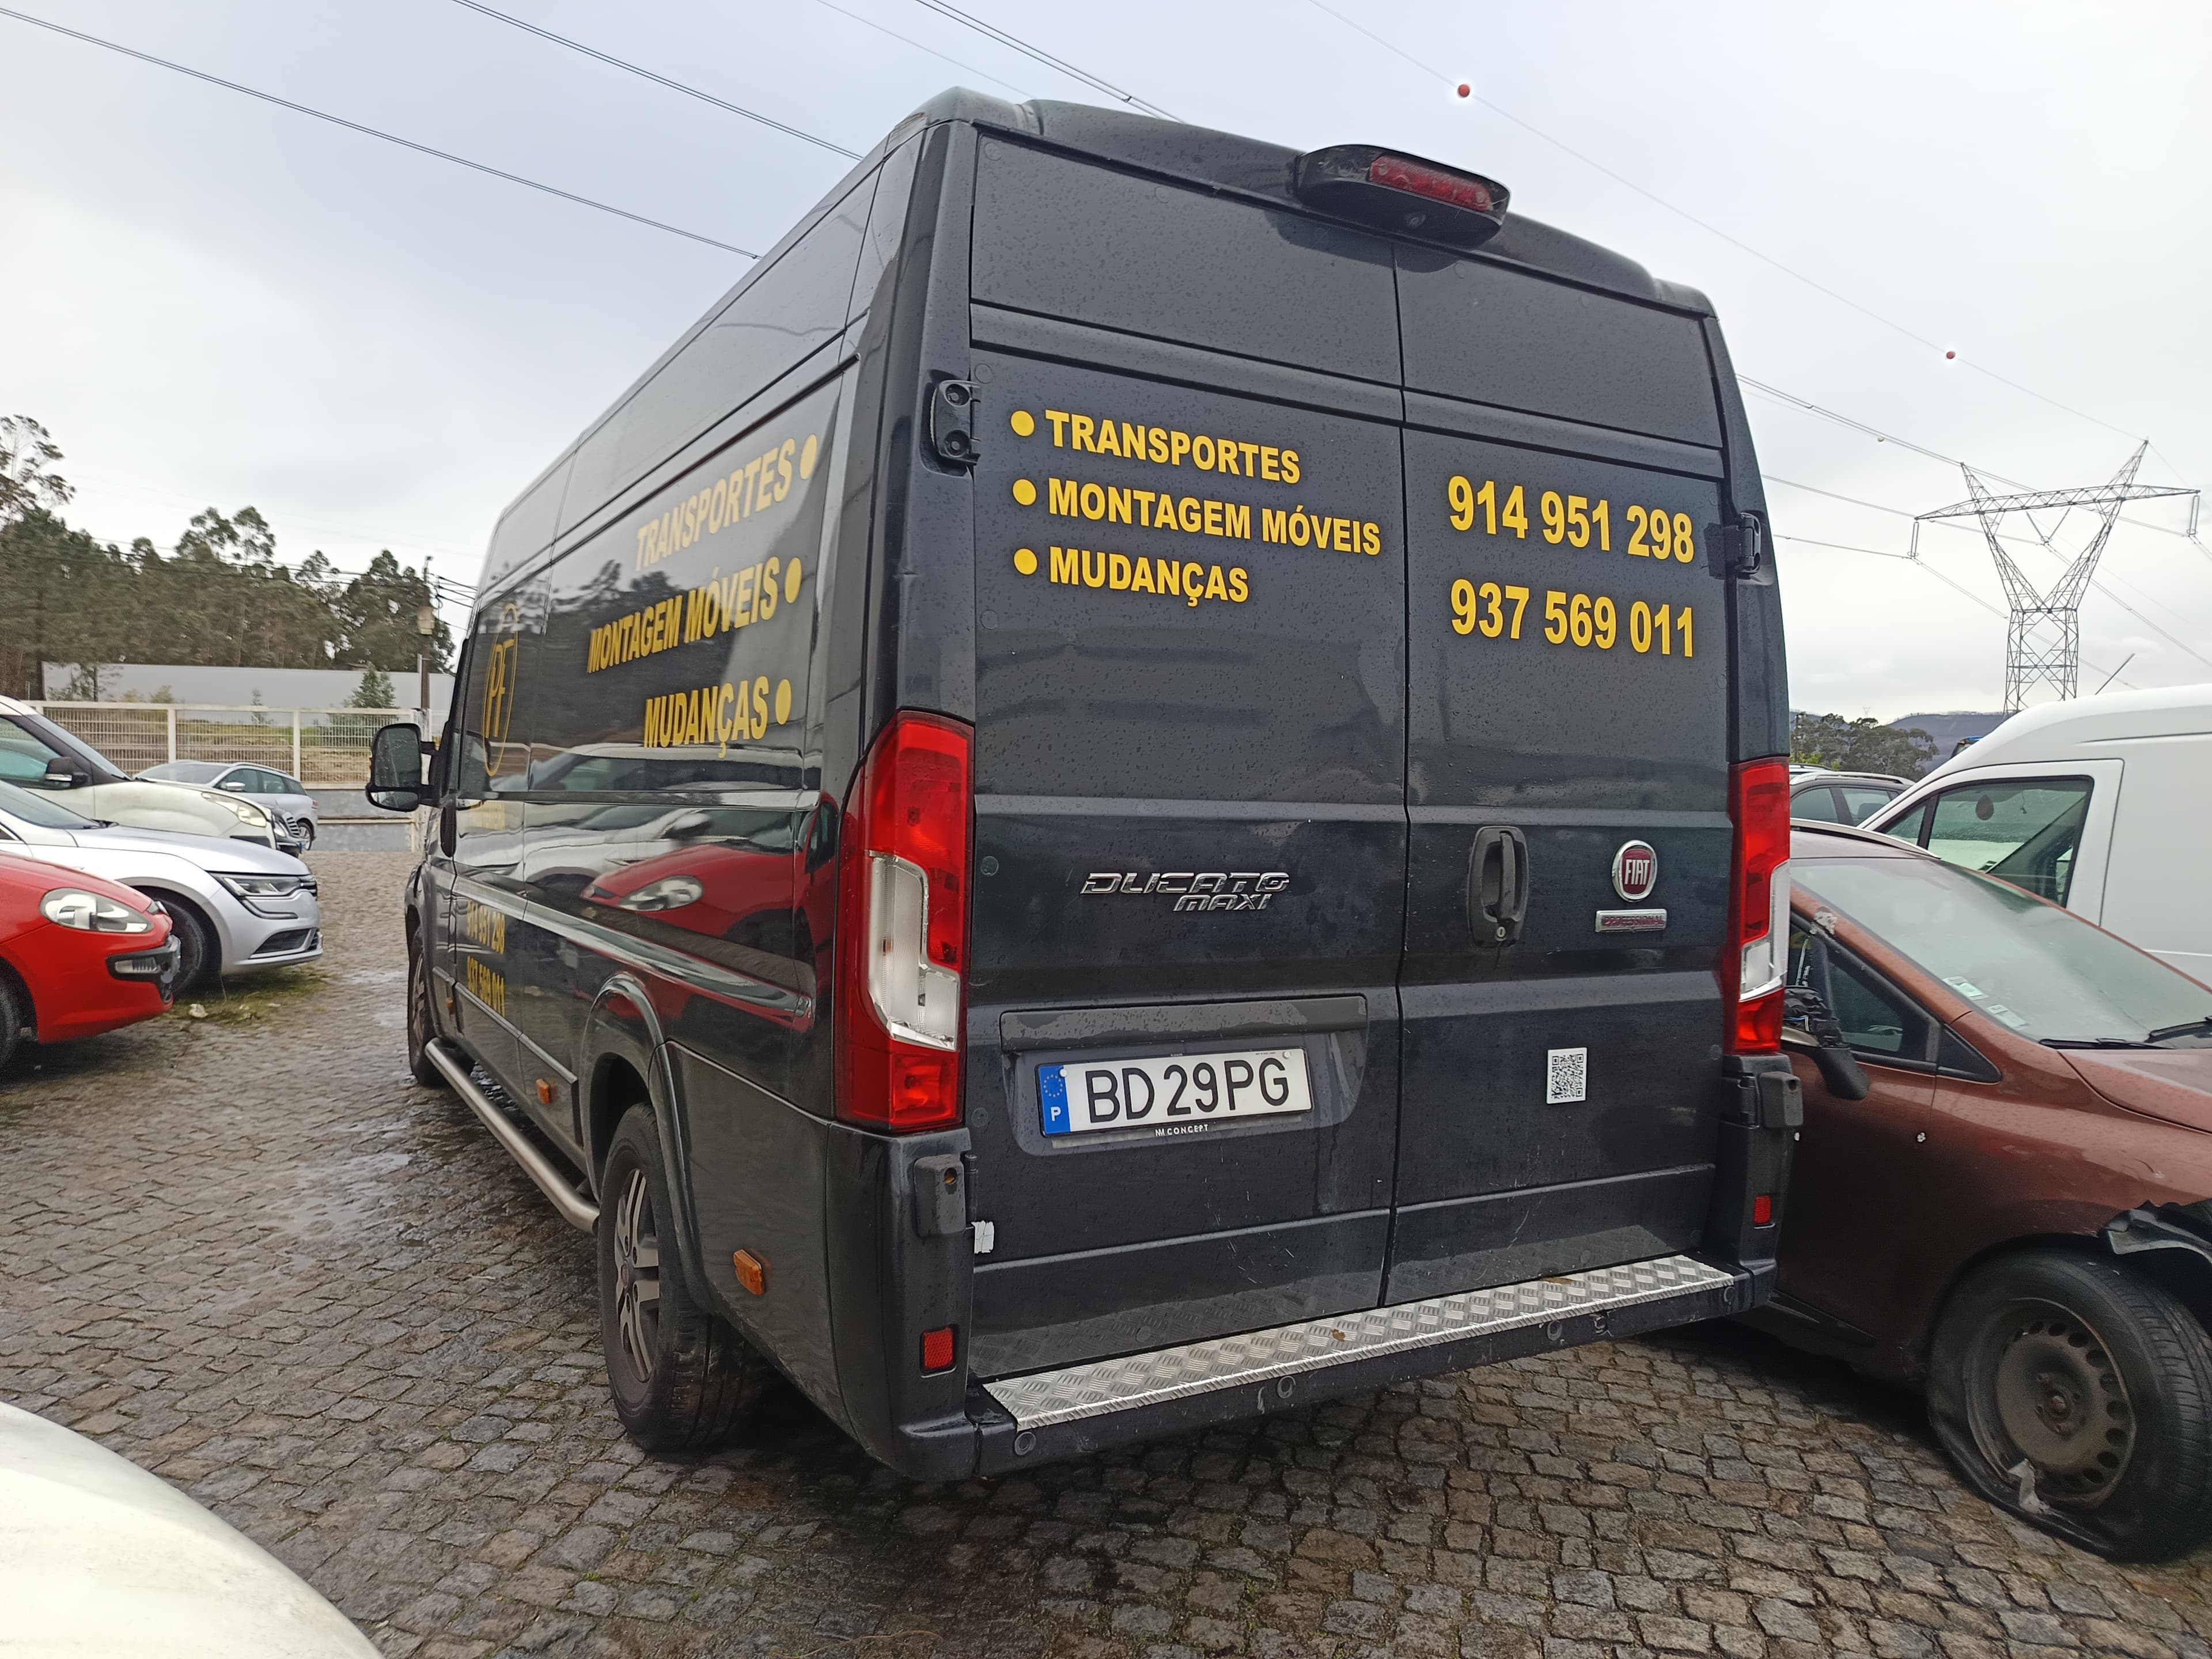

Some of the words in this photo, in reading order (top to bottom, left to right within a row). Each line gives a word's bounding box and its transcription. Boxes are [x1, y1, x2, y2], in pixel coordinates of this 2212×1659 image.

[1045, 410, 1301, 484] TRANSPORTES
[635, 438, 795, 571] TRANSPORTES
[1048, 478, 1251, 540] MONTAGEM
[1262, 505, 1381, 555] MÓVEIS
[1448, 475, 1528, 539] 914
[1541, 491, 1610, 551] 951
[1626, 505, 1694, 563] 298
[1049, 547, 1249, 607] MUDANÇAS
[587, 595, 683, 673] MONTAGEM
[684, 556, 780, 643] MÓVEIS
[1450, 578, 1529, 640] 937
[1544, 590, 1616, 649] 569
[1630, 600, 1693, 657] 011
[644, 676, 769, 759] MUDANÇAS
[1080, 873, 1290, 895] DUCATO
[1624, 859, 1650, 885] FIAT
[492, 911, 505, 954] 298
[1172, 894, 1272, 912] MAXI
[1603, 915, 1664, 927] PROFESSIONAL
[1051, 1107, 1061, 1121] P
[1167, 1124, 1209, 1135] CONCEPT
